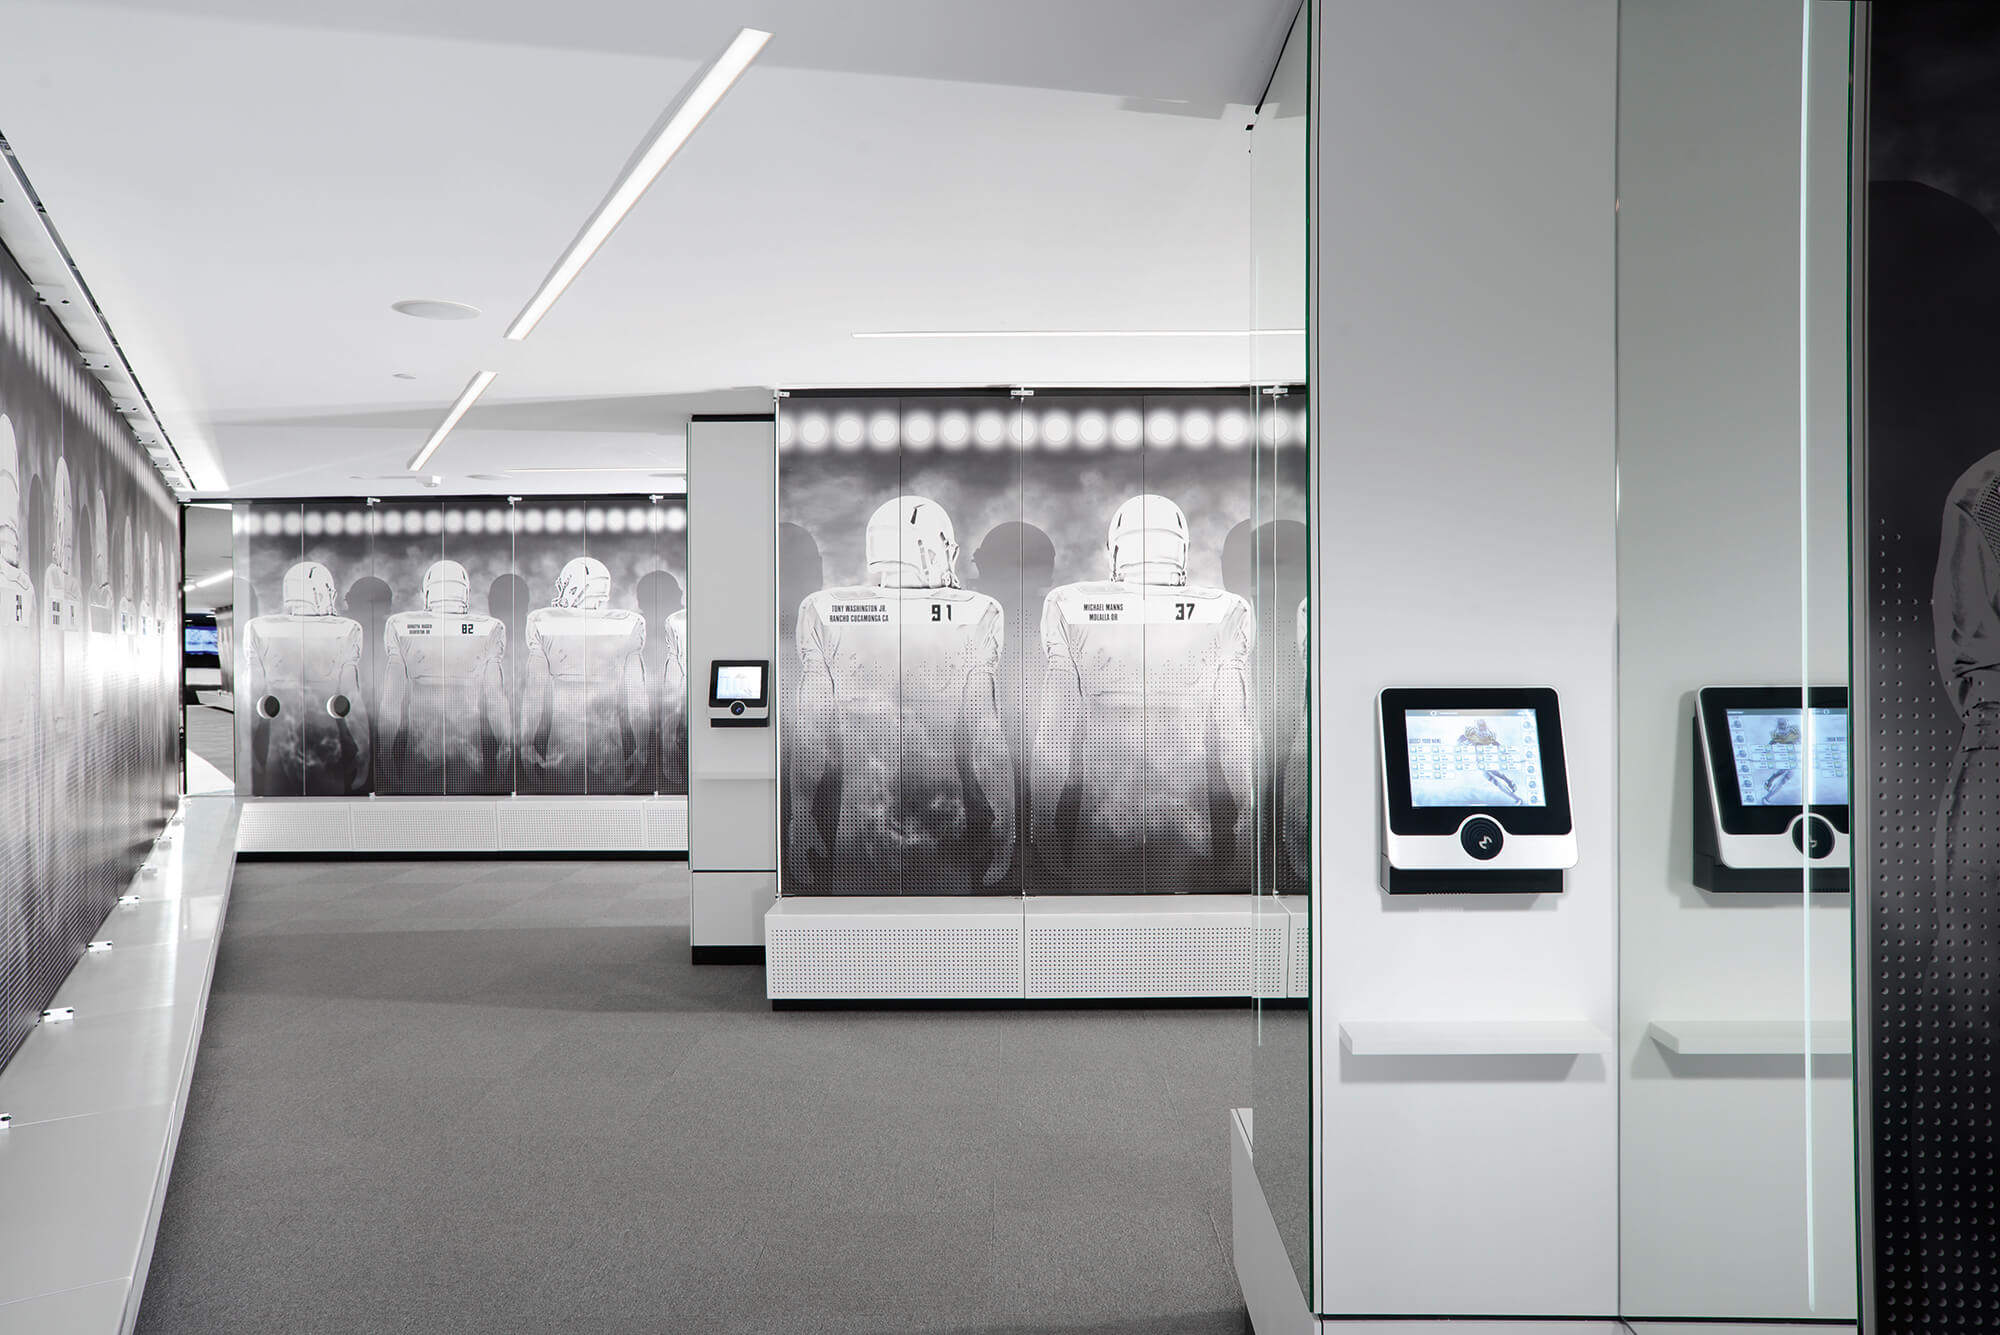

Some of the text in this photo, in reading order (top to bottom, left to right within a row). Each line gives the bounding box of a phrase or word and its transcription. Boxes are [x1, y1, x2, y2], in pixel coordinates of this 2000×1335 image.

[831, 605, 844, 613] TONY
[845, 605, 878, 613] WASHINGTON
[1083, 603, 1124, 611] MICHAEL MANNS
[1175, 603, 1195, 620] 37
[931, 604, 952, 622] 91
[1089, 613, 1118, 621] MOLALLA OR
[829, 614, 889, 623] RANCHO CUCAMONGA CA
[461, 624, 474, 634] 82
